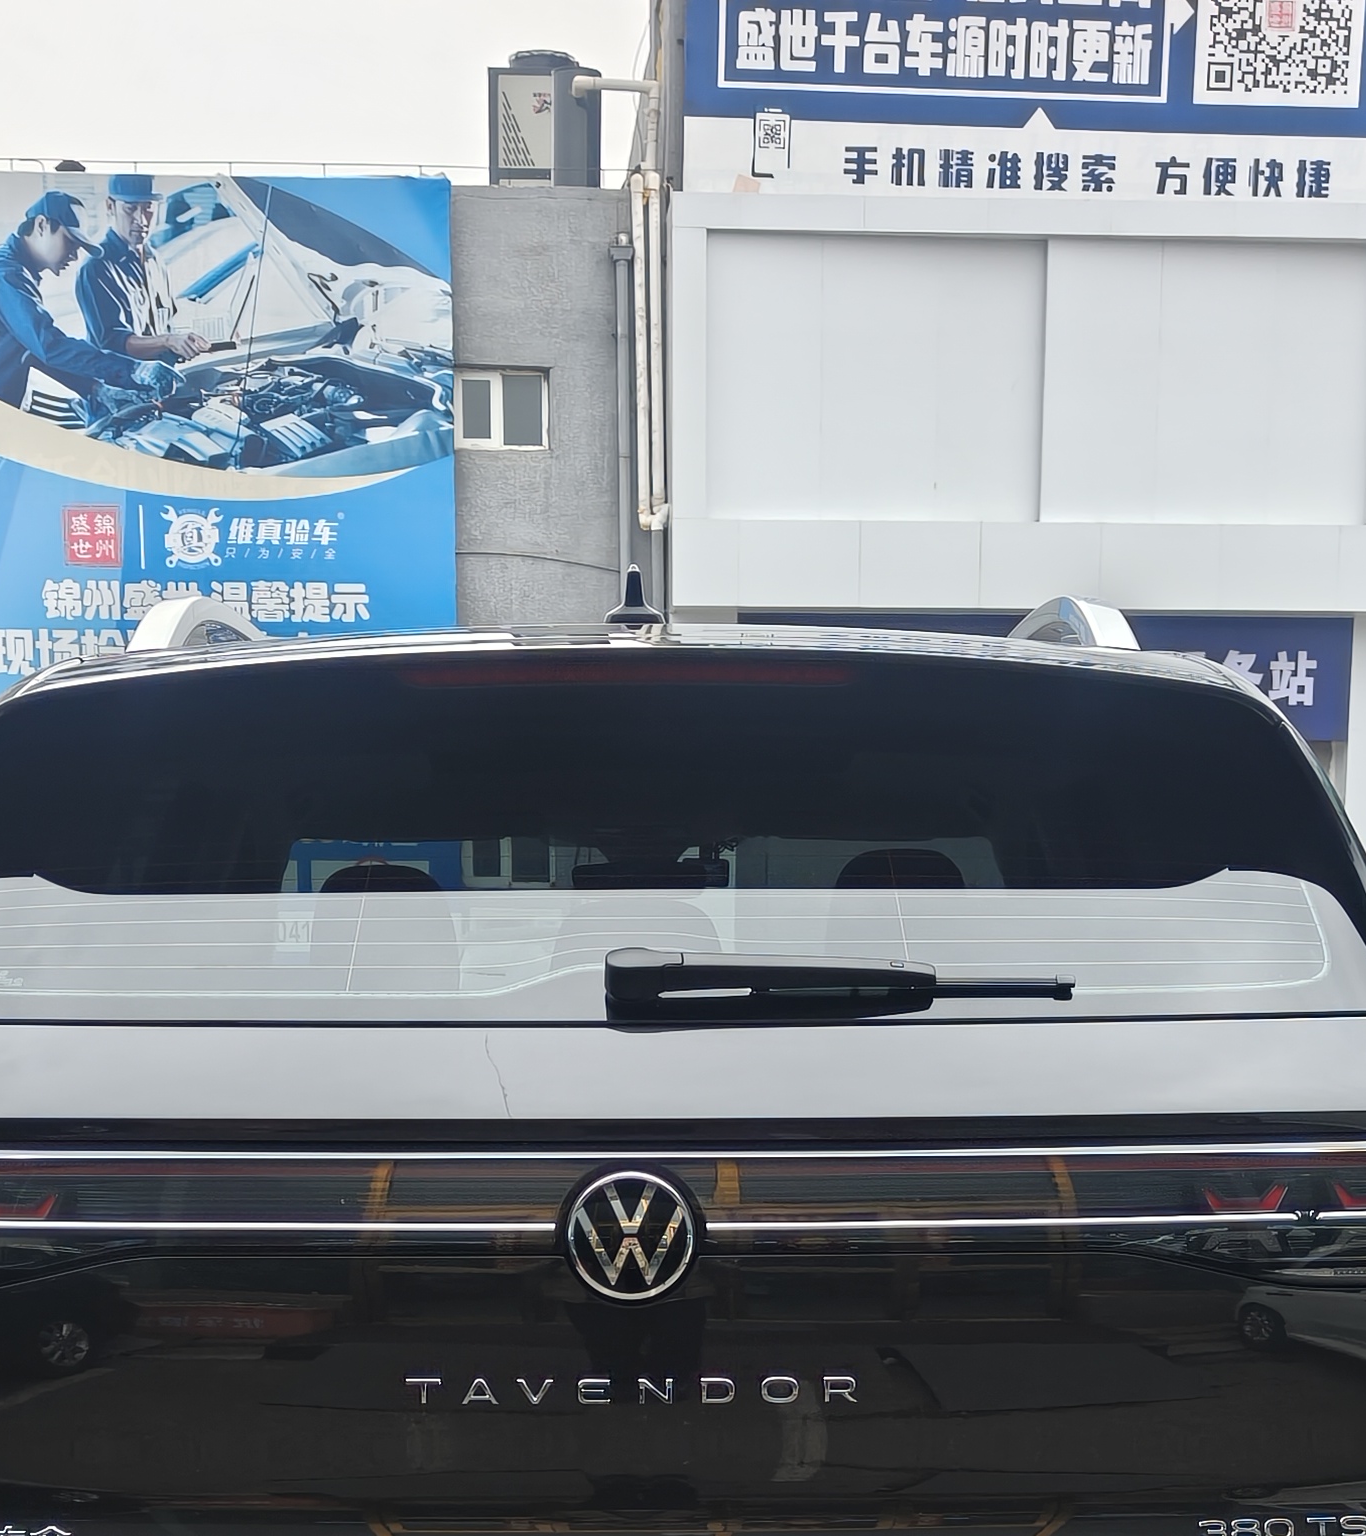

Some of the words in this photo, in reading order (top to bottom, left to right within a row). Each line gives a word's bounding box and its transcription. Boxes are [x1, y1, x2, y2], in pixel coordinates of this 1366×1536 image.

[736, 8, 1154, 85] 盛世千台车源时时更新
[843, 145, 1117, 194] 手机精准搜索
[1155, 156, 1333, 199] 方便快捷
[227, 517, 339, 546] 维真验车
[404, 1376, 859, 1406] TAVENDOR
